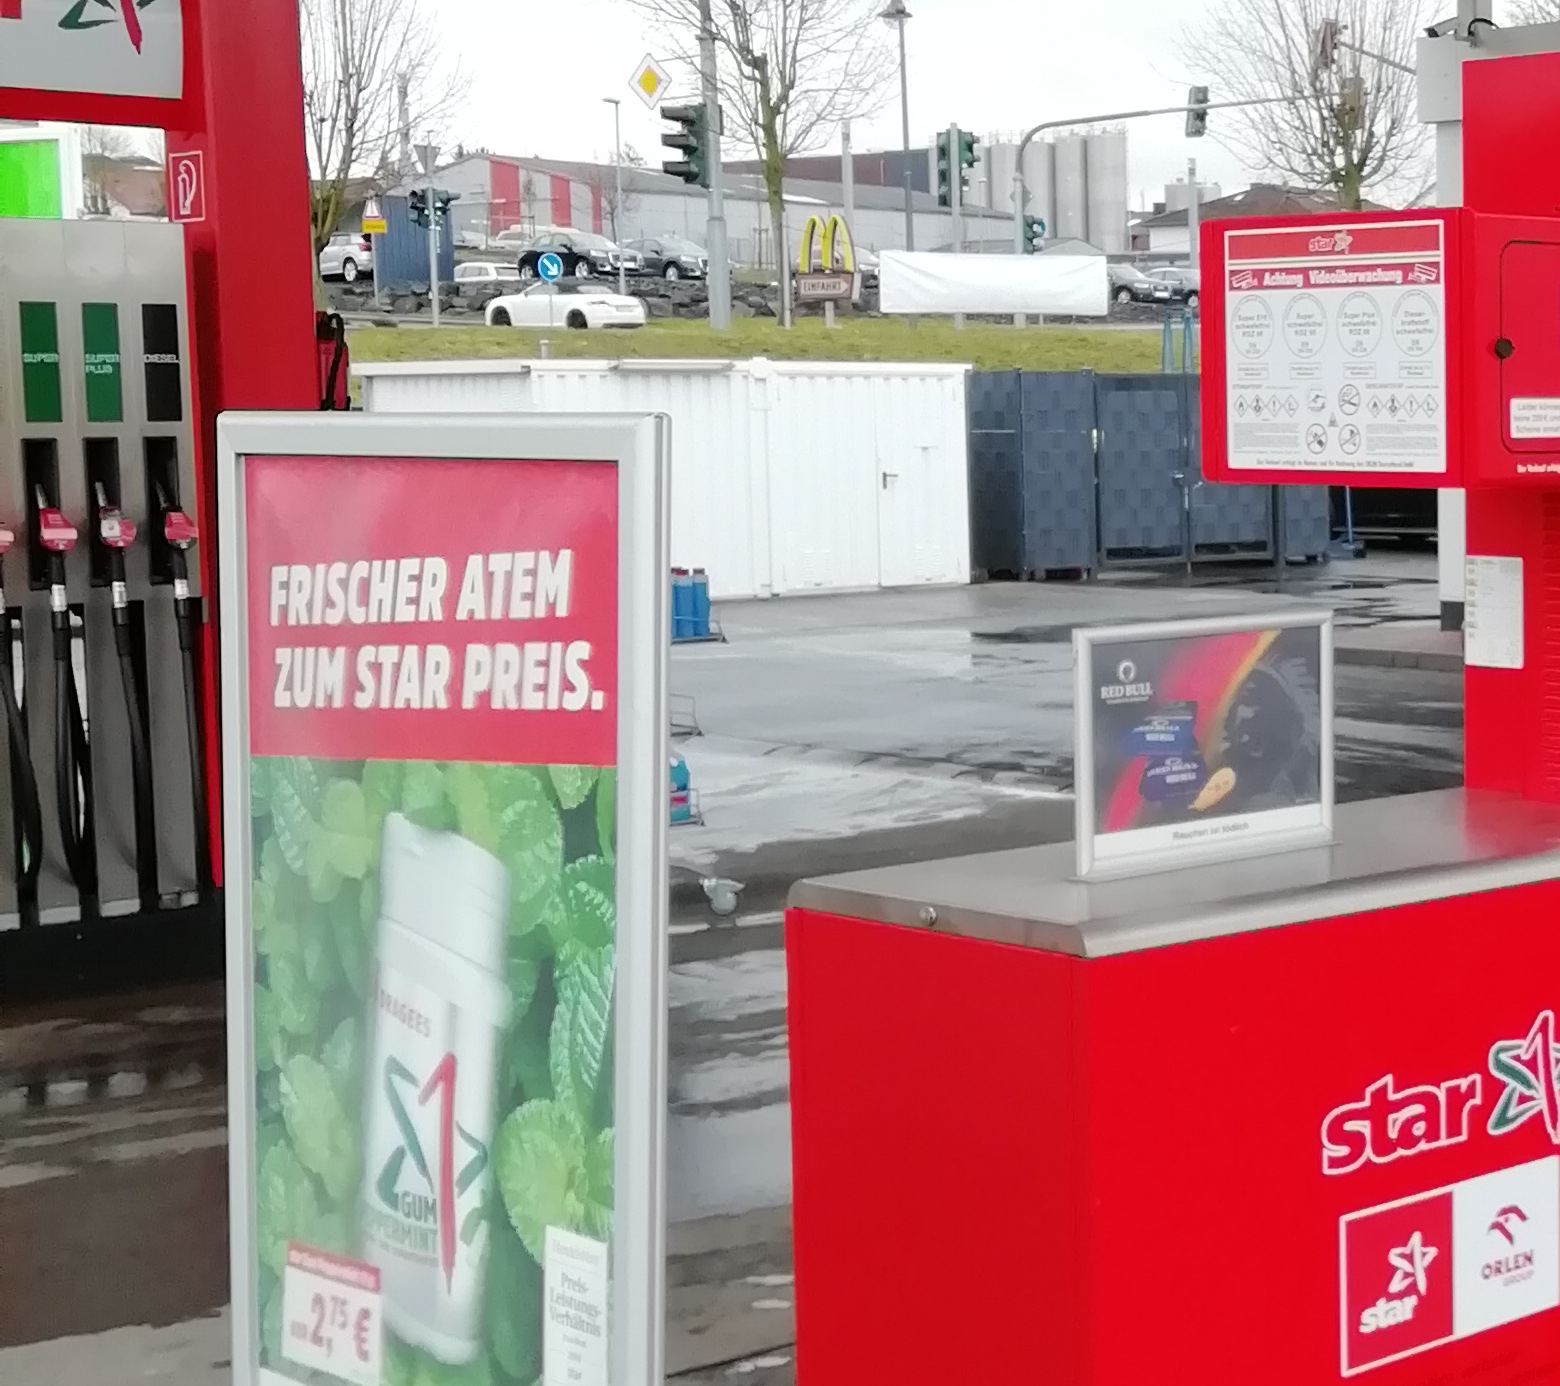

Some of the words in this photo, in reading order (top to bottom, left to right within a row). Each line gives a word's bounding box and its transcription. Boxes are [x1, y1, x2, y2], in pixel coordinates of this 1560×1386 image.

[269, 556, 448, 626] FRISCHER
[455, 548, 573, 621] ATEM
[274, 646, 346, 708] ZUM
[353, 644, 451, 710] STAR
[461, 640, 605, 711] PREIS.
[1101, 685, 1125, 699] RED
[1125, 682, 1154, 696] BULL
[1320, 1073, 1482, 1175] star
[401, 1189, 438, 1225] GUM
[1481, 1249, 1534, 1280] ORLEN
[1359, 1294, 1419, 1334] star
